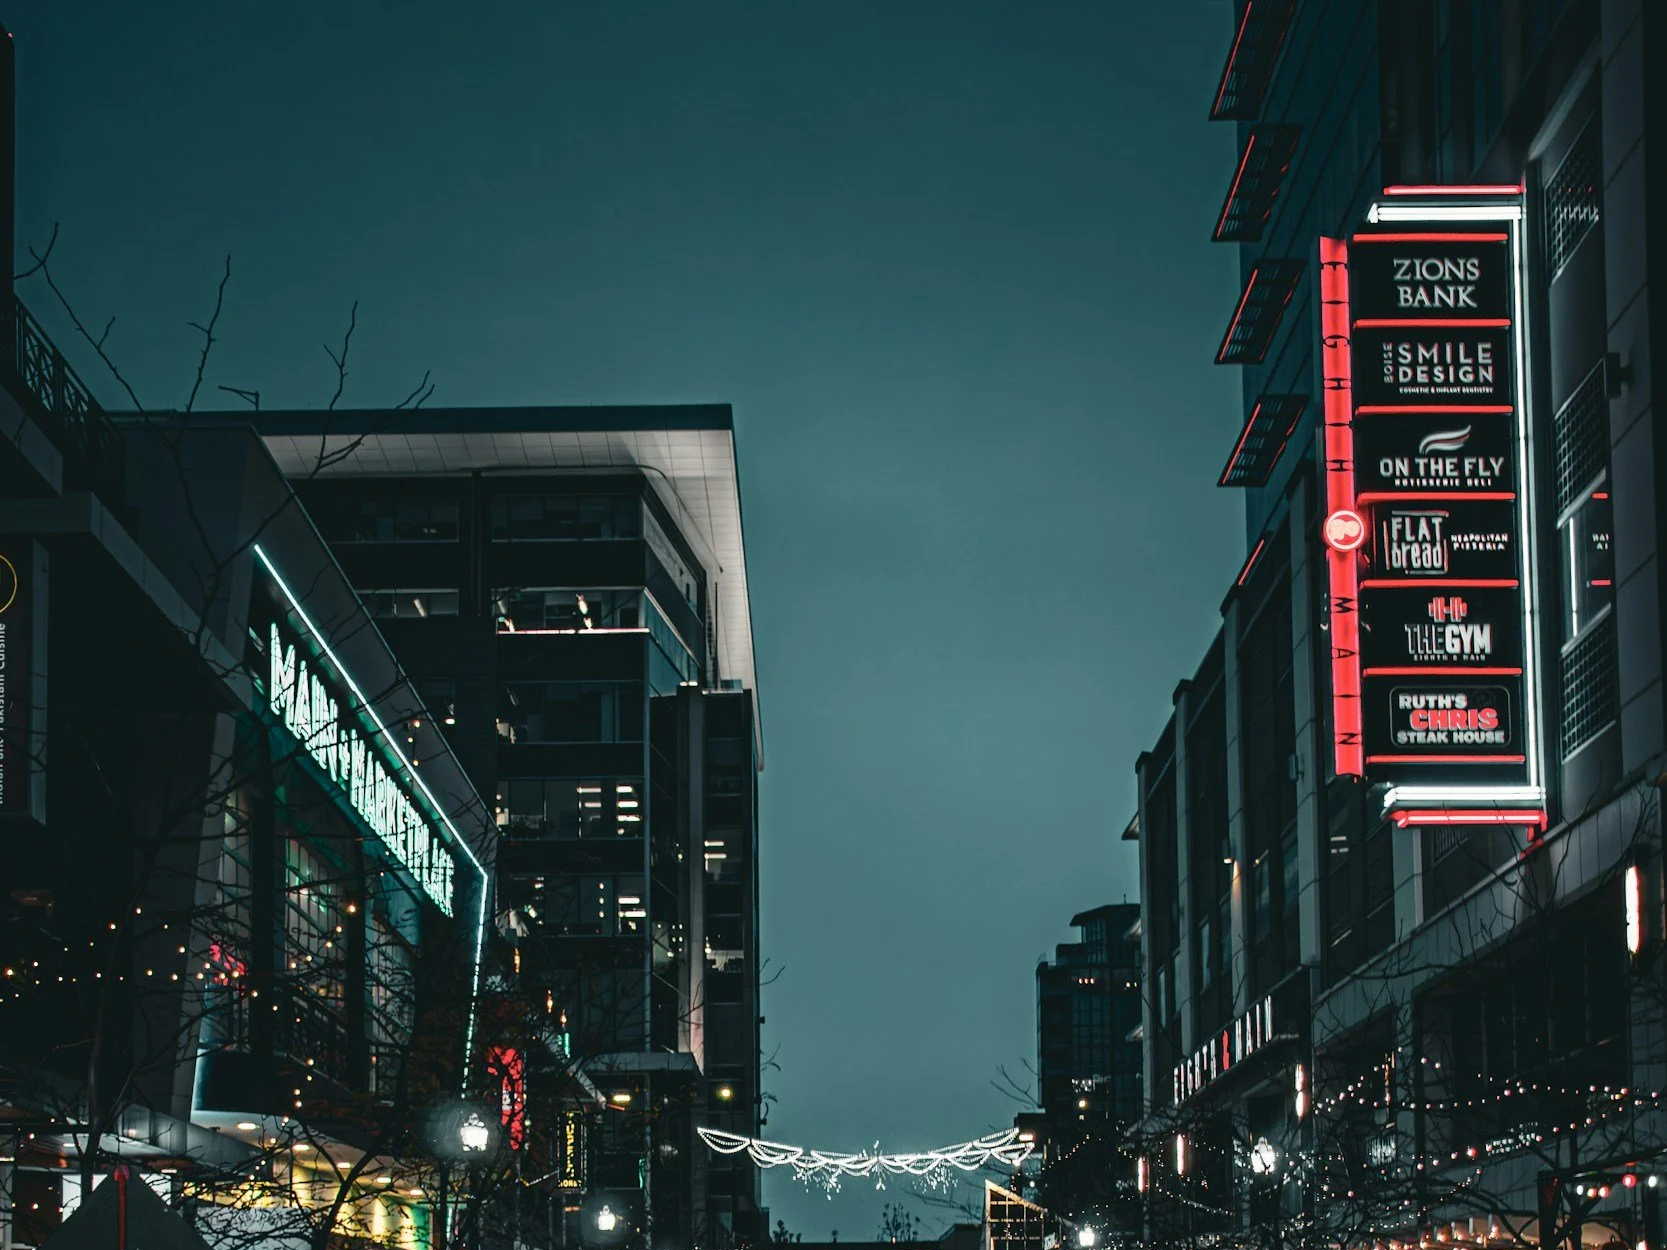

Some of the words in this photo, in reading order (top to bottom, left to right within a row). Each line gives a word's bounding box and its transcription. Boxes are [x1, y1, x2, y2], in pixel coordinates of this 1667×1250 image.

[1393, 257, 1481, 281] ZIONS
[1397, 284, 1478, 308] BANK
[1382, 342, 1394, 384] BOISE
[1398, 342, 1493, 364] SMILE
[1398, 365, 1493, 384] DESIGN
[1379, 457, 1410, 478] ON
[1414, 457, 1459, 477] THE
[1464, 456, 1504, 477] FLY
[1391, 517, 1443, 542] FLAT
[1451, 533, 1508, 543] NEAPOLITAN
[1391, 541, 1443, 569] bread
[1398, 693, 1468, 709] RUTH'S
[1409, 707, 1499, 731] CHRIS
[1396, 729, 1449, 744] STEAK
[1452, 730, 1505, 744] HOUSE
[269, 621, 339, 782] MAIN
[350, 729, 455, 919] MARKETPLACE
[1235, 995, 1273, 1064] MAIN
